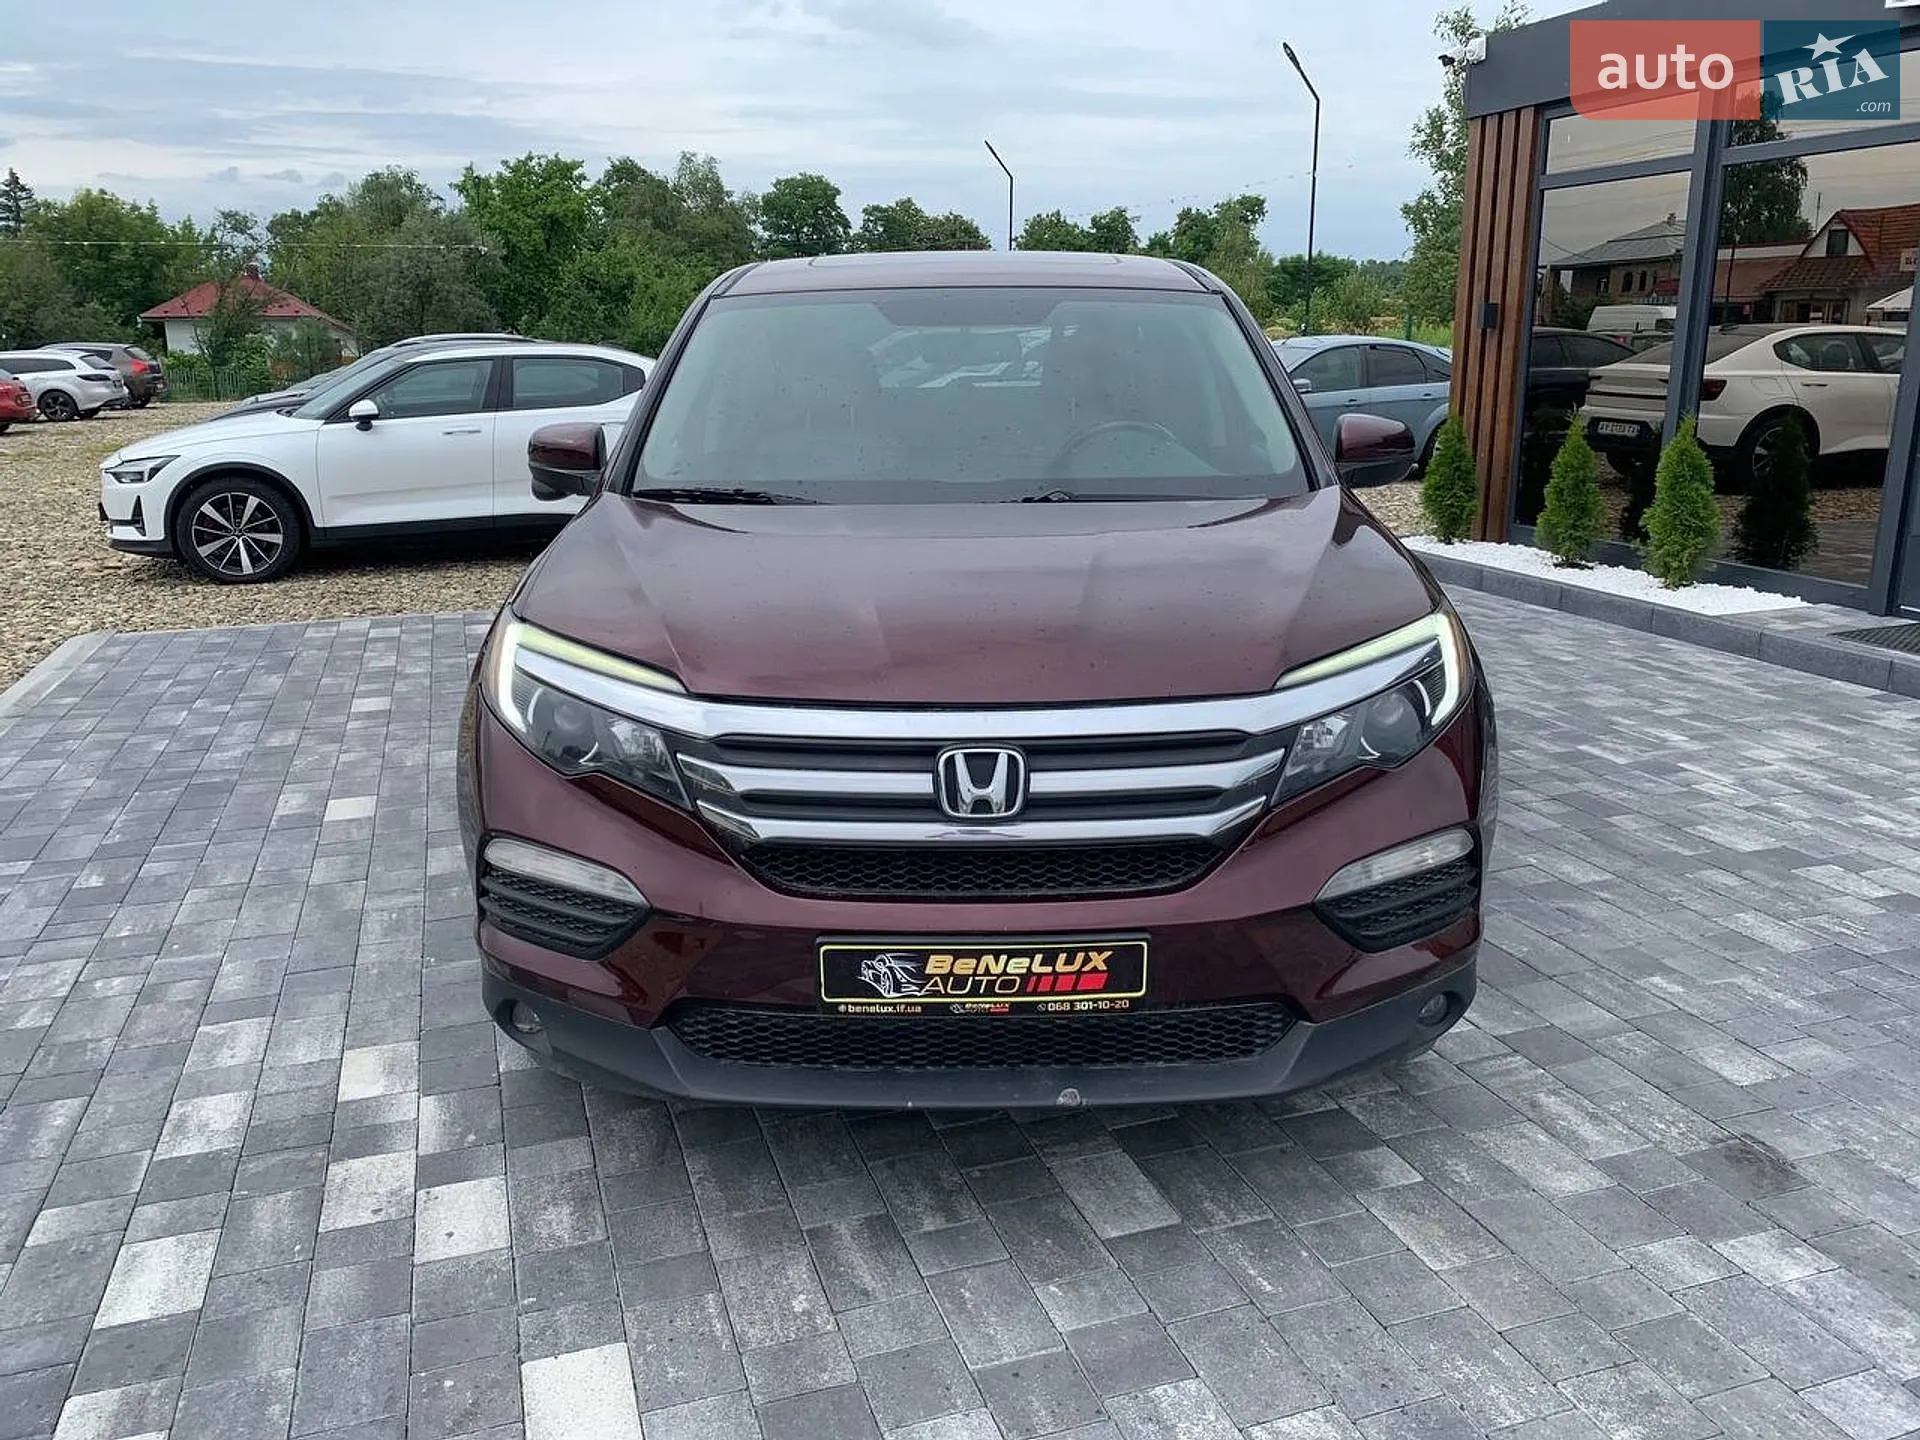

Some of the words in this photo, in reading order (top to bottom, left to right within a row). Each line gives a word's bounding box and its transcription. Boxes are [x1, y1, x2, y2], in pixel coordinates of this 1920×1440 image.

[920, 976, 1021, 994] AUTO
[848, 1004, 922, 1014] benelux.if.ua
[1048, 1002, 1070, 1012] 068
[1073, 1000, 1129, 1010] 301-10-20
